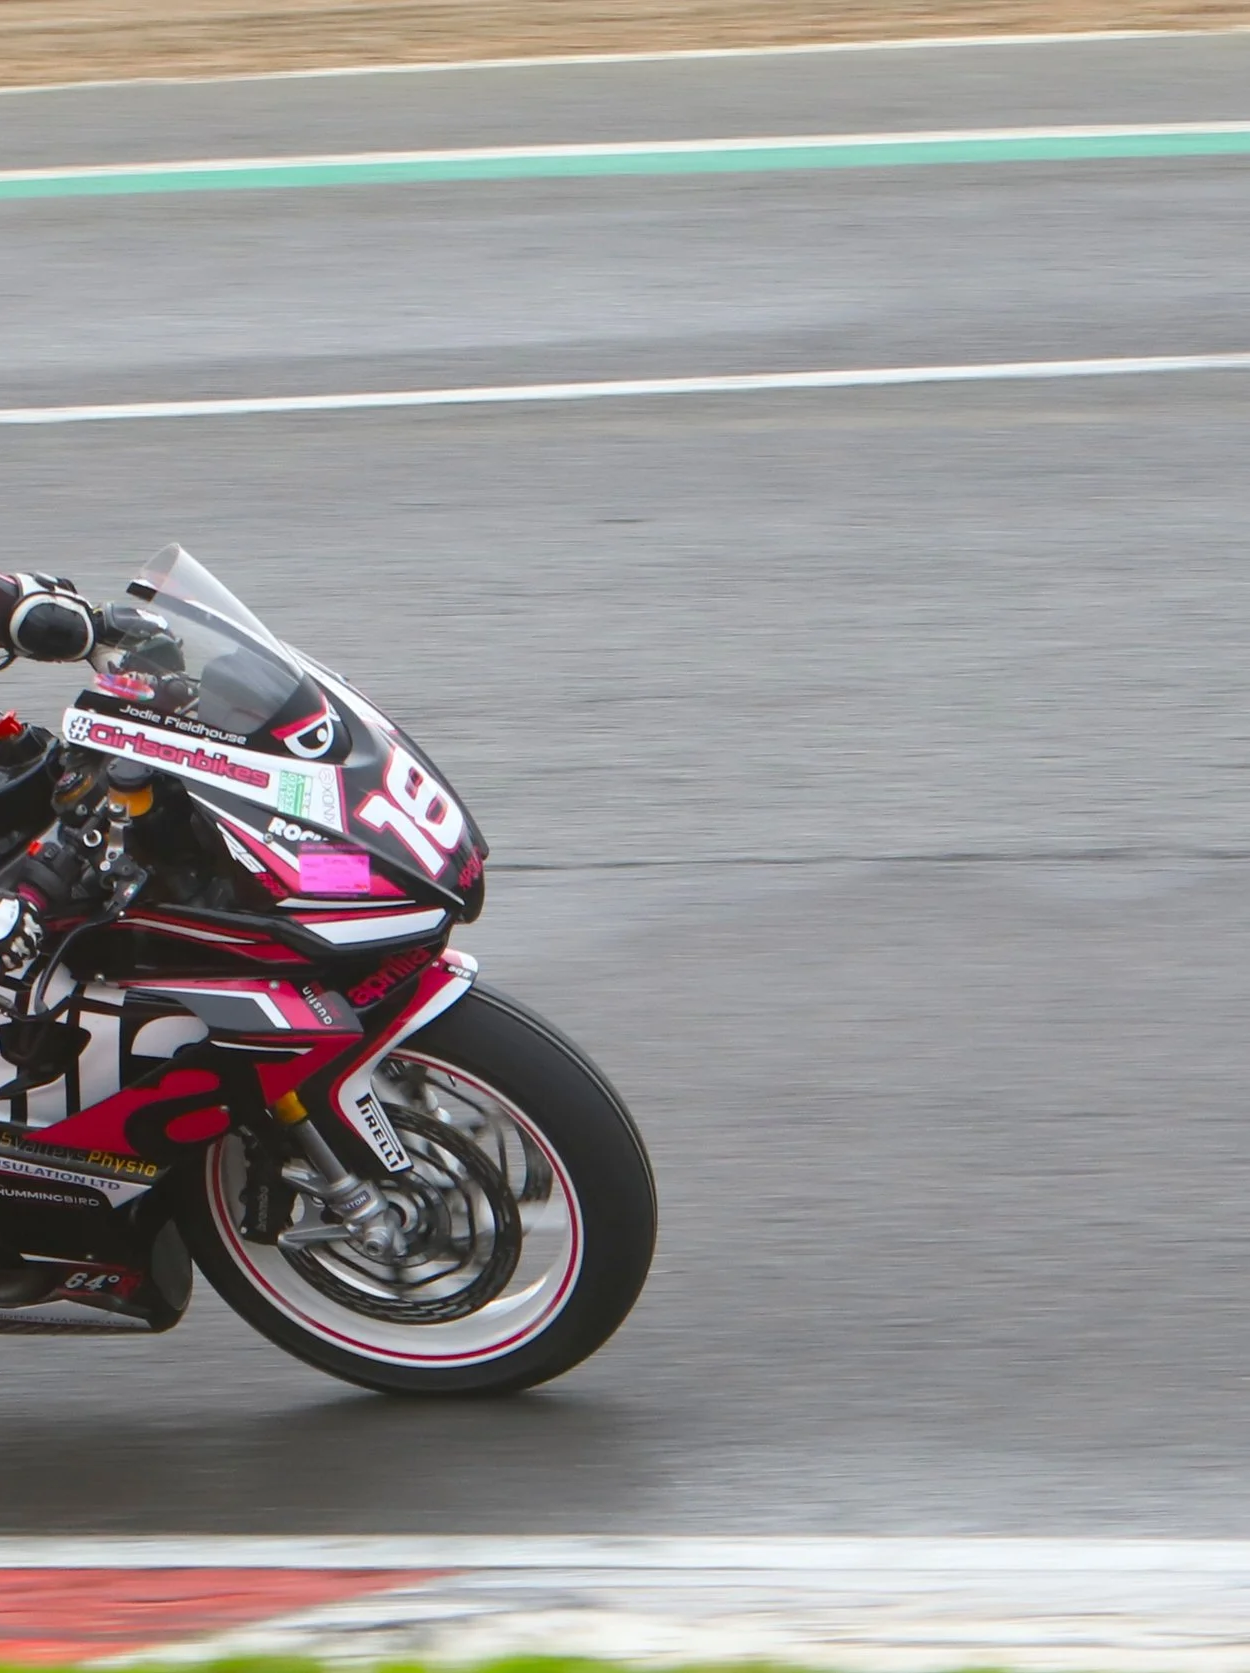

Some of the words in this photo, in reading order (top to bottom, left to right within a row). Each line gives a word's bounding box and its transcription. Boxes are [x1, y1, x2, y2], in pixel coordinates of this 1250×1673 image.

[119, 704, 161, 724] Jodie
[164, 715, 248, 746] Fieldhouse
[68, 715, 271, 790] #Girlsonbikes
[322, 778, 336, 827] KNOX
[355, 743, 465, 881] 18
[302, 985, 334, 1026] austin
[356, 1093, 405, 1170] PIRELLI
[90, 1174, 121, 1190] LTD
